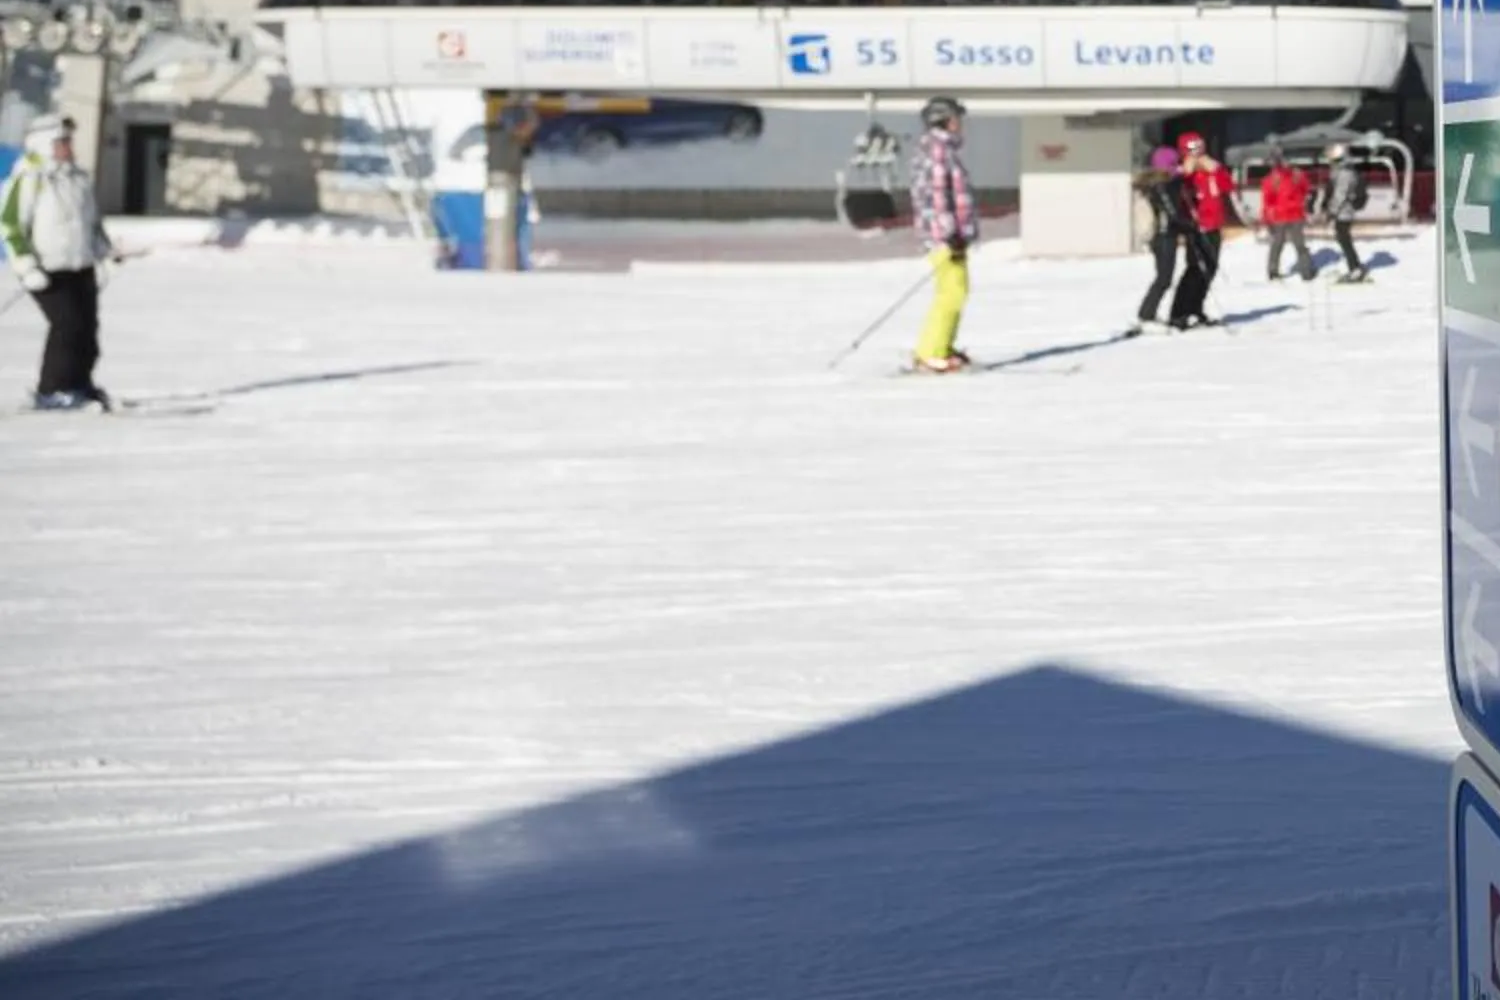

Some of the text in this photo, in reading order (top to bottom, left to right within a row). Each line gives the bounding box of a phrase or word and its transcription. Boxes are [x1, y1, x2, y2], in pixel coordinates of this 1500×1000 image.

[857, 39, 1216, 66] 55 Sasso Levante
